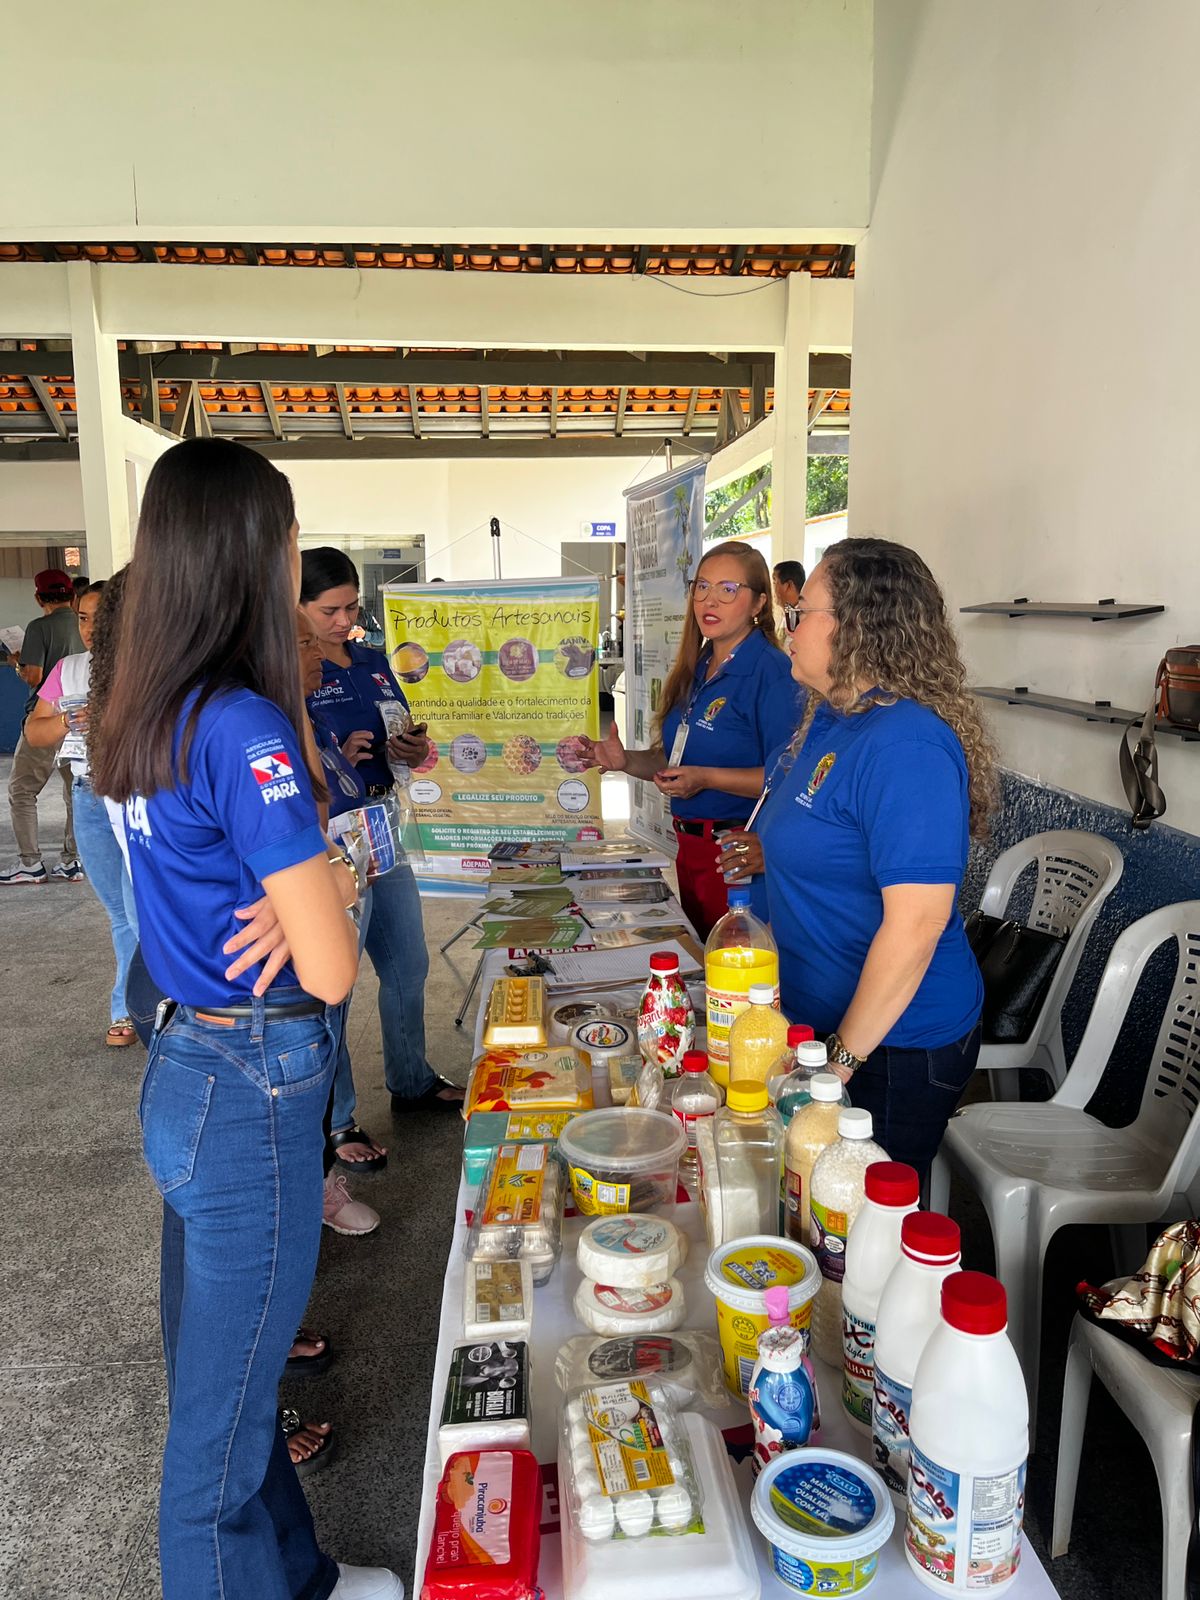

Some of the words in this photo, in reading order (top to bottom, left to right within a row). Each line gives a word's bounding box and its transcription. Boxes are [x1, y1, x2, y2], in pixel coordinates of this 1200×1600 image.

[390, 608, 482, 629] Produtos
[492, 607, 591, 628] Artesanais
[409, 697, 447, 708] arantindo
[456, 697, 498, 710] qualidade
[515, 696, 578, 707] fortalecimento
[580, 696, 592, 706] da
[411, 710, 450, 722] gricultura
[452, 711, 483, 721] Familiar
[492, 710, 543, 721] Valorizando
[458, 793, 491, 801] LEGALIZE
[799, 1480, 813, 1491] DE
[809, 1477, 853, 1506] MANTEIGA
[833, 1477, 857, 1493] CALU
[475, 1482, 488, 1533] Piracanjuba
[794, 1497, 816, 1512] COM
[815, 1509, 830, 1523] SAL
[450, 1511, 461, 1539] queijo
[925, 1562, 948, 1581] 900g
